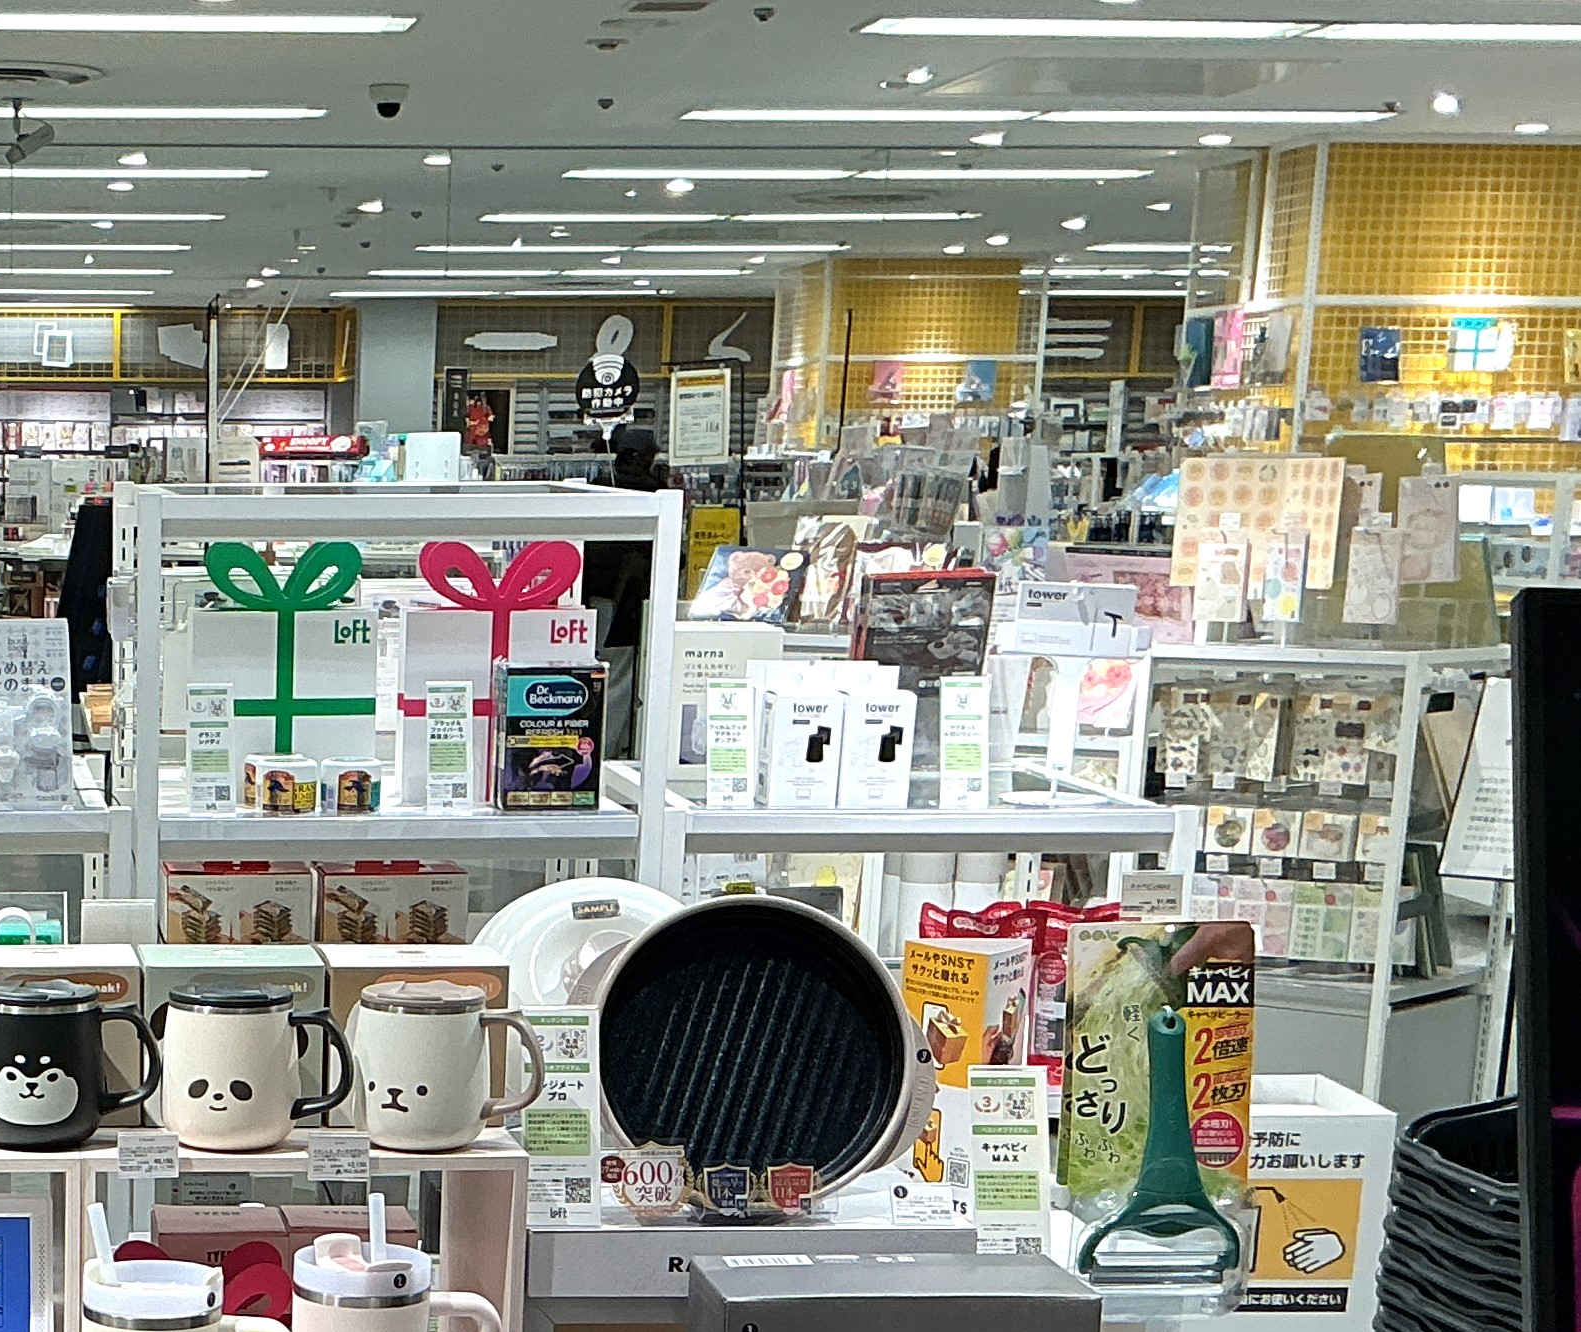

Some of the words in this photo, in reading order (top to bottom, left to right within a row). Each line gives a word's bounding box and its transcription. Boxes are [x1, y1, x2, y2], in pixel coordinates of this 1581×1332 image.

[581, 386, 633, 399] 防犯カメラ
[591, 397, 625, 409] 作動中
[1027, 588, 1068, 602] tower
[333, 619, 372, 646] Loft
[549, 619, 589, 645] Loft
[683, 650, 725, 659] marna
[528, 693, 583, 705] Beckmann
[793, 702, 829, 714] tower
[865, 702, 901, 713] tower
[576, 902, 616, 915] SAMPLE
[909, 949, 976, 971] メールやSNSで
[1187, 965, 1251, 979] キャベピィ
[1186, 981, 1251, 1004] MAX
[1122, 1004, 1141, 1042] 軽く
[1194, 1027, 1213, 1066] 2
[1074, 1033, 1127, 1135] どっさり
[547, 1090, 568, 1102] プロ
[1192, 1071, 1211, 1112] 2
[1251, 1131, 1302, 1147] 予防に
[981, 1142, 1029, 1153] キャベピィ
[991, 1154, 1021, 1163] MAX
[1249, 1153, 1366, 1169] 力お願いします
[622, 1159, 674, 1187] 600
[634, 1185, 673, 1204] 突破
[548, 1206, 569, 1219] Loft
